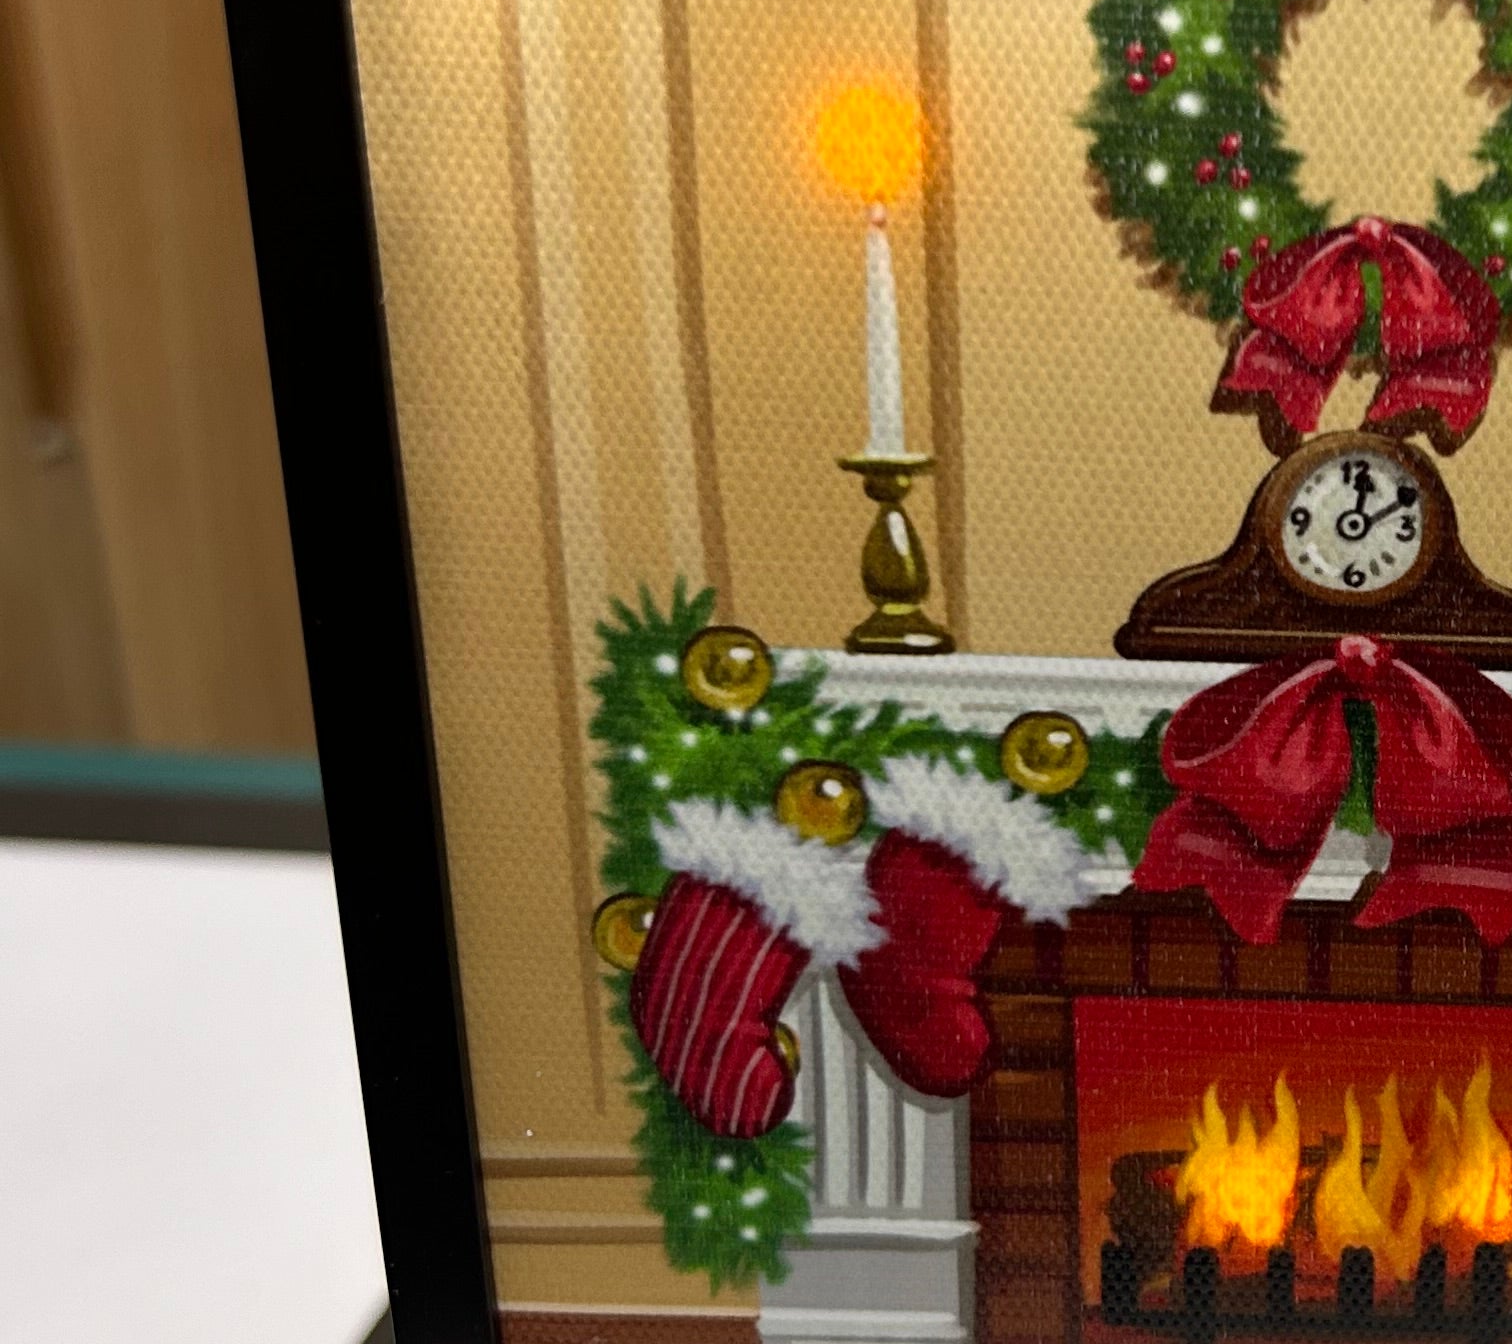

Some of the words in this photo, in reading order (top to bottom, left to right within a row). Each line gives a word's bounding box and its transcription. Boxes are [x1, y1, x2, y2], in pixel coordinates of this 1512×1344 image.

[1290, 506, 1311, 537] 9
[1396, 515, 1416, 542] 3
[1343, 563, 1366, 588] 6
